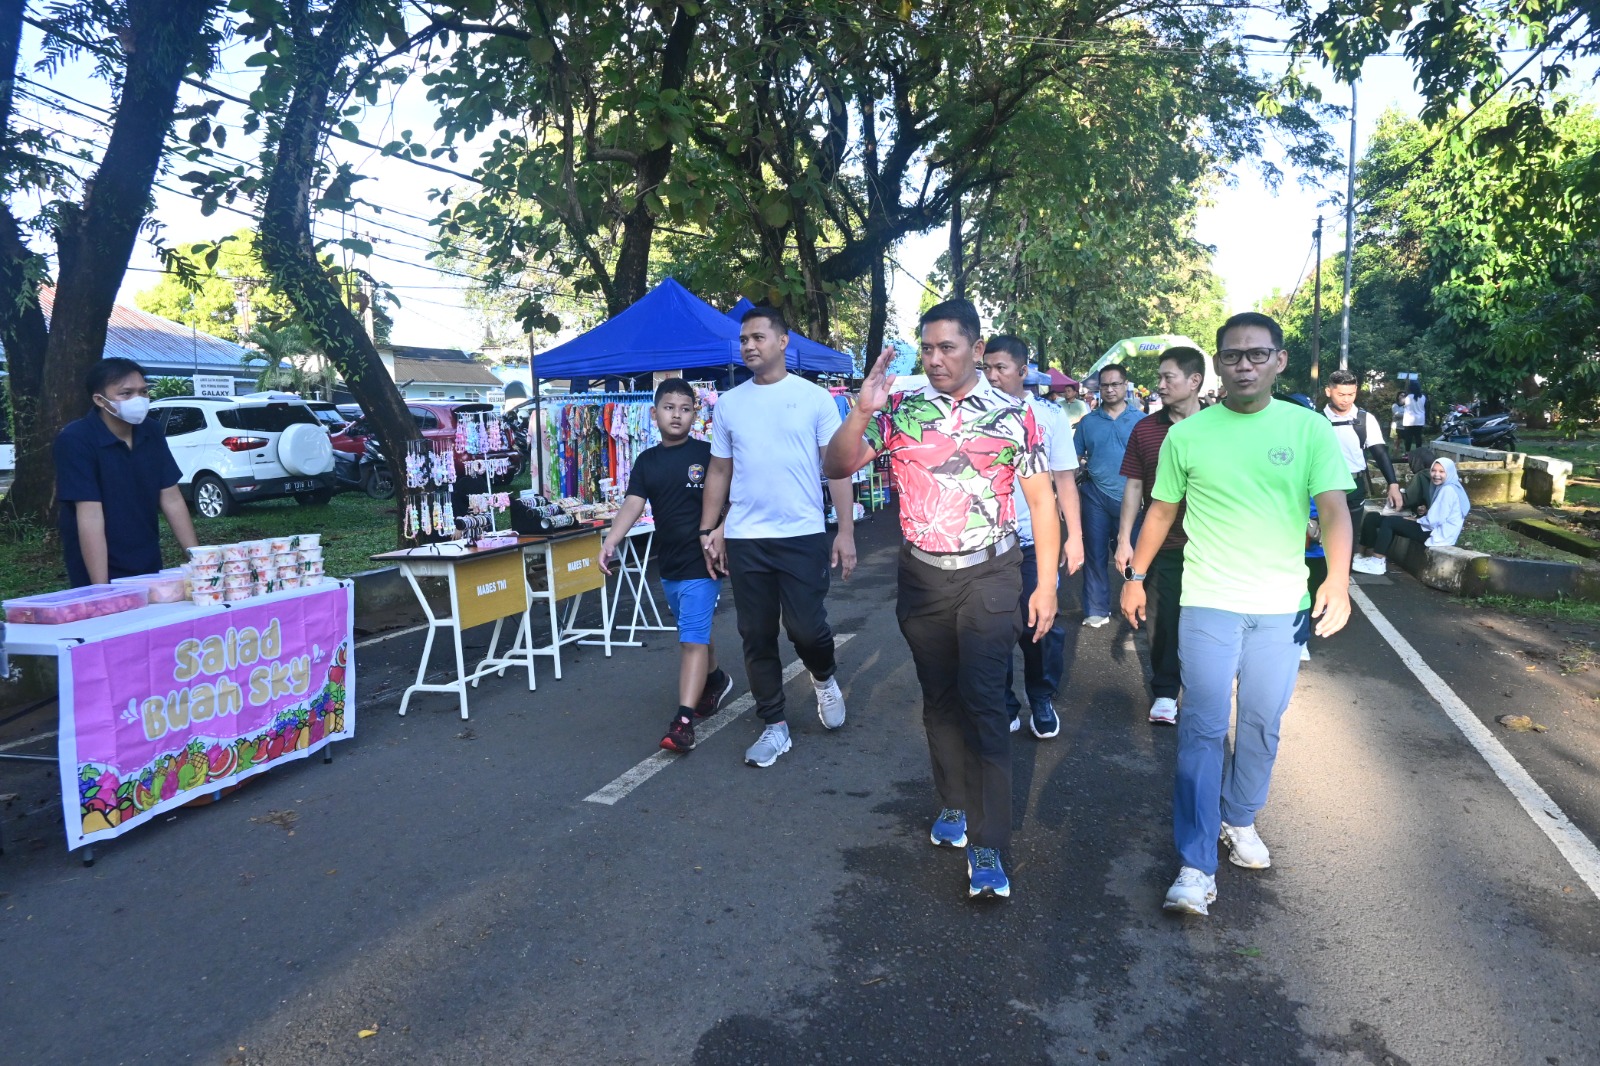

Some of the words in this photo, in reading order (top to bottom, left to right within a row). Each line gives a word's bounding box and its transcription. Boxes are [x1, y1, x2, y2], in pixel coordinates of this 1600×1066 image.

[477, 581, 497, 597] MABES
[497, 579, 507, 590] TNI
[174, 618, 281, 682] Salad
[141, 676, 243, 741] Buah
[249, 654, 311, 706] Sky
